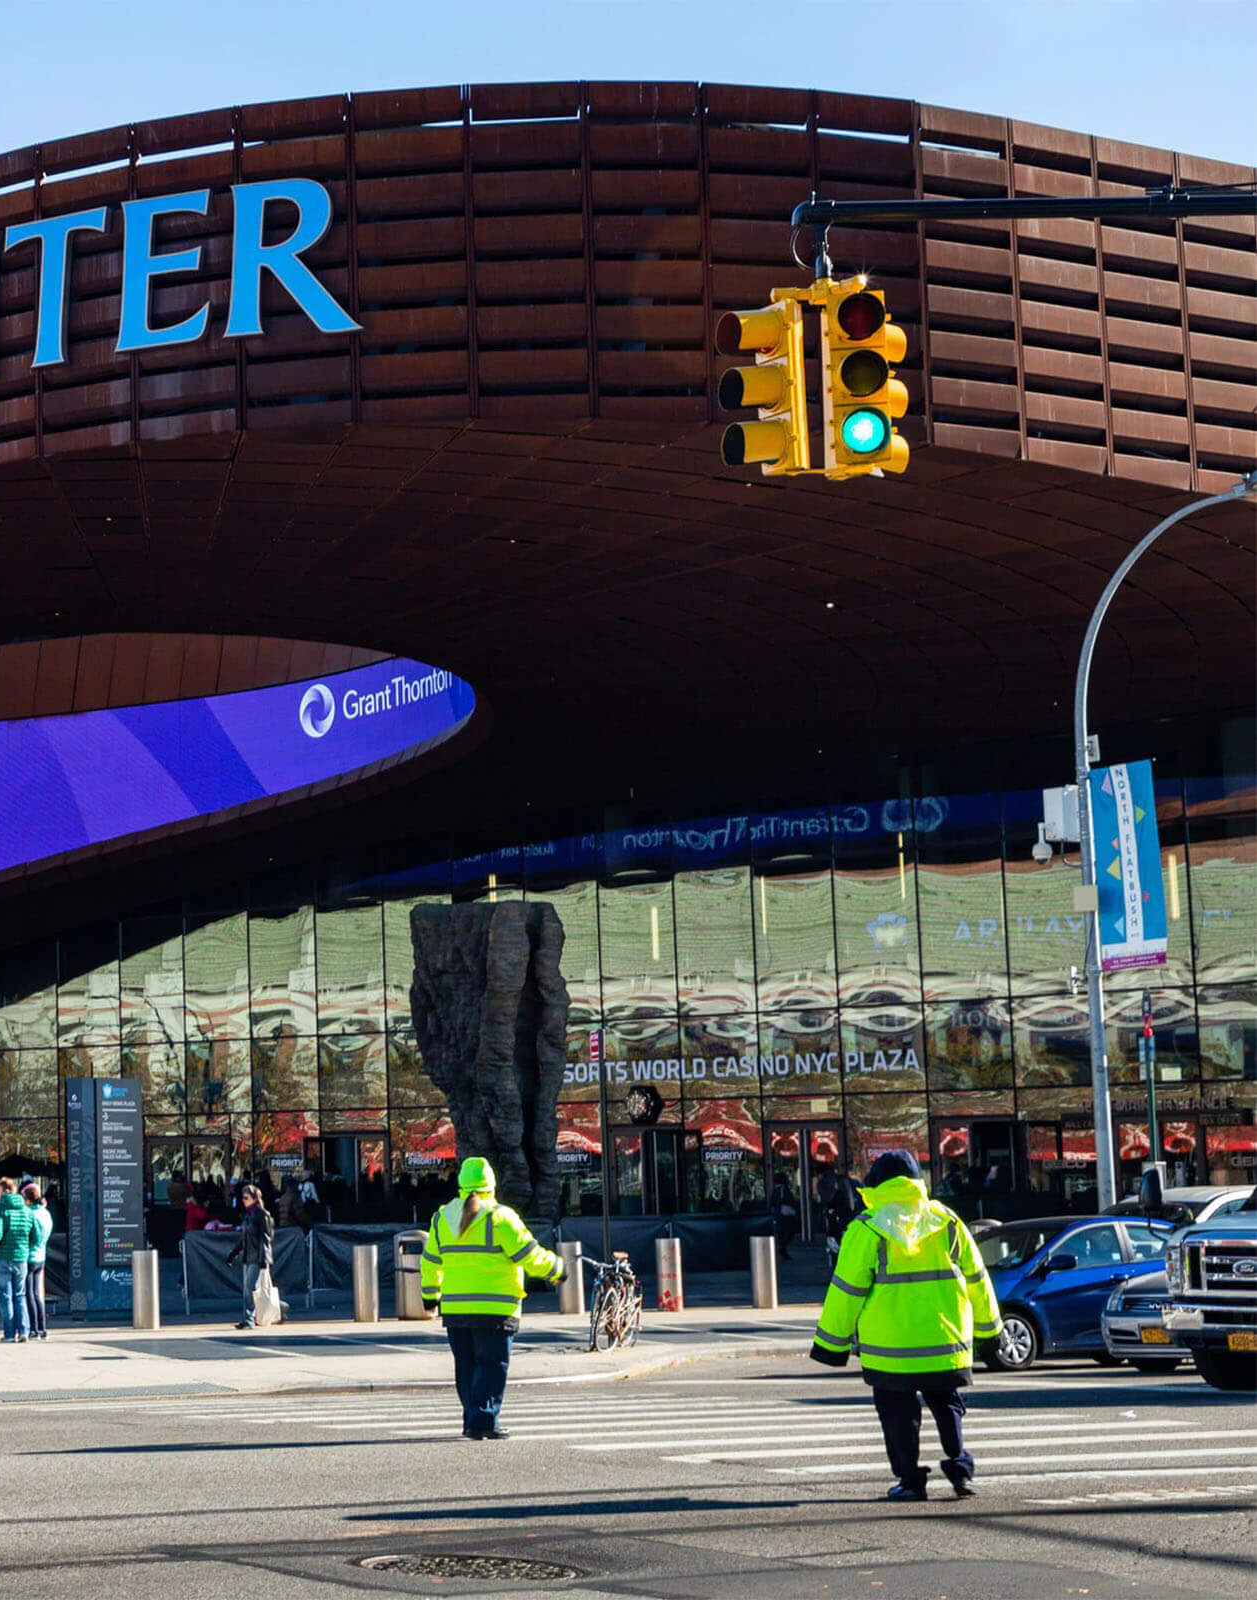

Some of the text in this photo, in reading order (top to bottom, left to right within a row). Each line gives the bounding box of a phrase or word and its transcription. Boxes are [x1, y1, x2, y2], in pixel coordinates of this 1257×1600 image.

[343, 668, 453, 720] Grant Thornton
[1114, 768, 1130, 826] NORTH
[1124, 834, 1139, 928] FLATBUSH
[563, 1048, 920, 1084] SORTS WORLD CASINO NYC PLAZA
[70, 1120, 80, 1156] PLAY
[706, 1151, 743, 1161] PRIORITY
[271, 1158, 304, 1167] PRIORITY
[407, 1156, 442, 1165] PRIORITY
[557, 1153, 588, 1162] RIORITY
[70, 1167, 81, 1203] DINE
[71, 1216, 82, 1279] UNWIND
